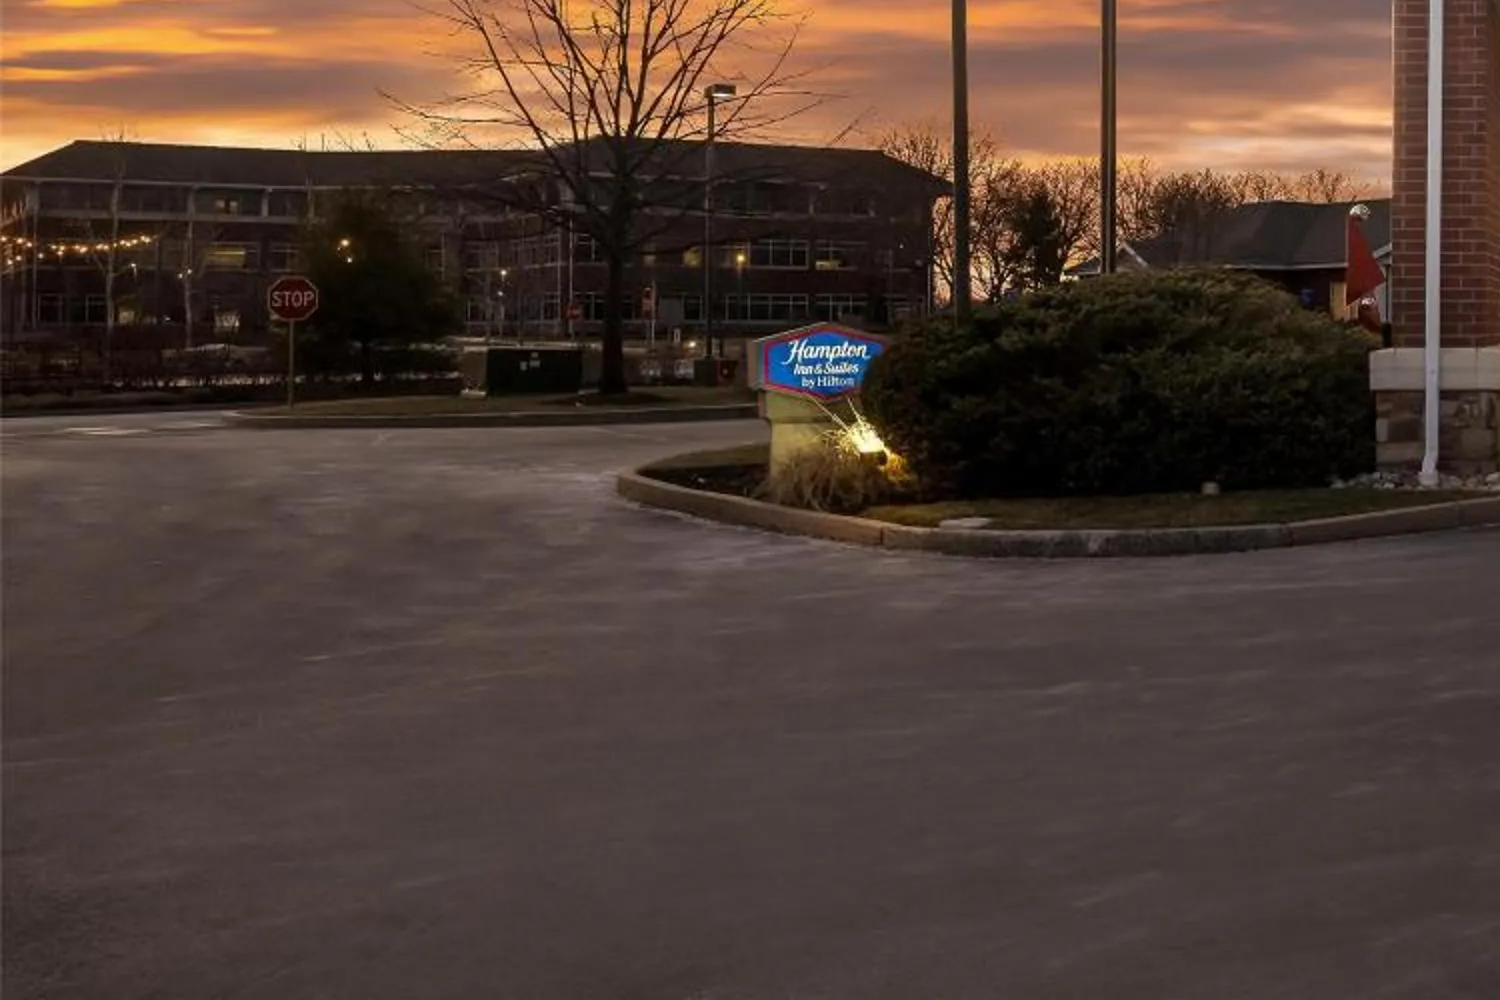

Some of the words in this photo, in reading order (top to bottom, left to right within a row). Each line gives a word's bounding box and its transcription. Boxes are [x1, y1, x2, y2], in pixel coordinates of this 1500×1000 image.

[271, 291, 315, 308] STOP
[780, 339, 872, 365] Hampton
[793, 363, 813, 375] Inn
[823, 362, 860, 374] Suites
[801, 375, 816, 389] by
[817, 374, 856, 388] Hilton
